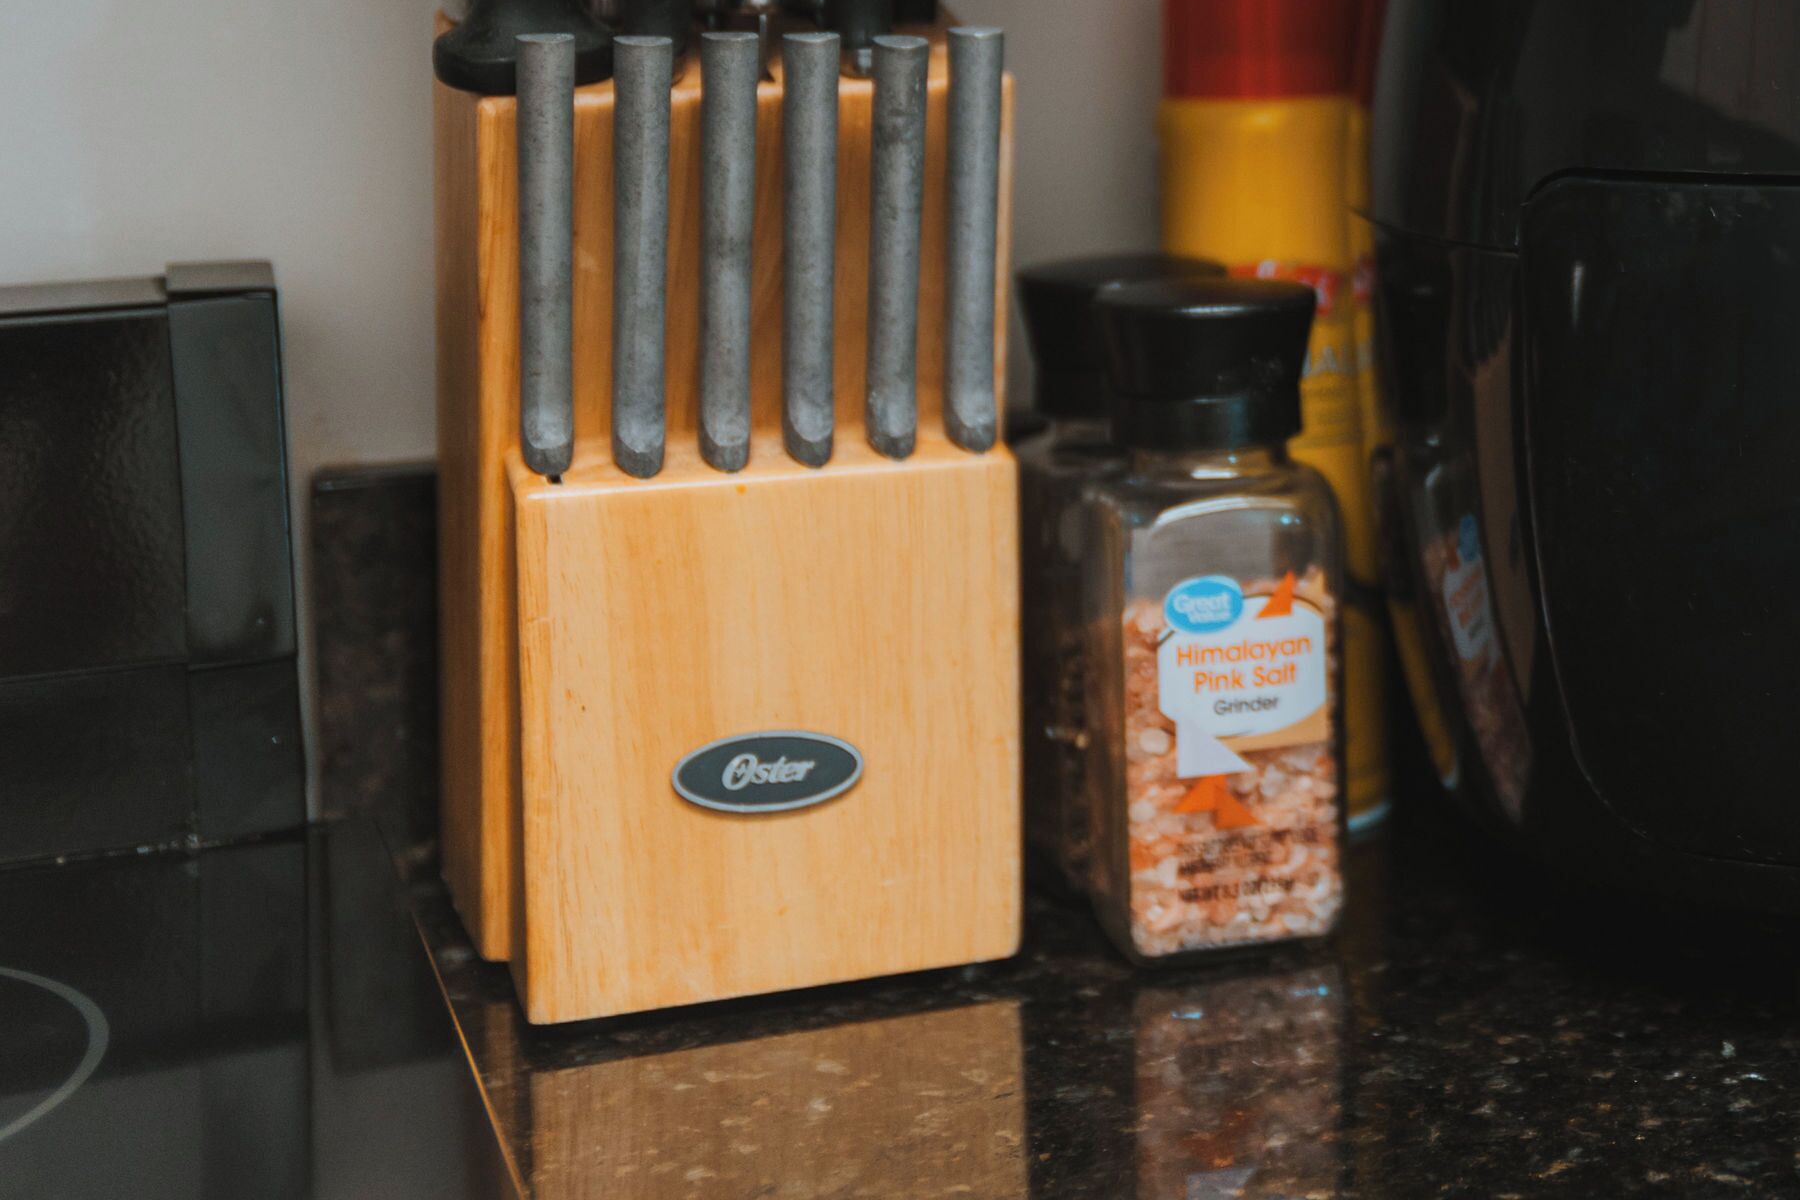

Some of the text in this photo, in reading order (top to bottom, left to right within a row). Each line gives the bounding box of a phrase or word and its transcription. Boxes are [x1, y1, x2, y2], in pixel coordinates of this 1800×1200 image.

[1174, 593, 1229, 613] Great
[1176, 636, 1312, 667] Himalayan
[1194, 663, 1297, 693] Pink Salt
[1213, 696, 1279, 715] Grinder
[722, 753, 815, 790] Oster
